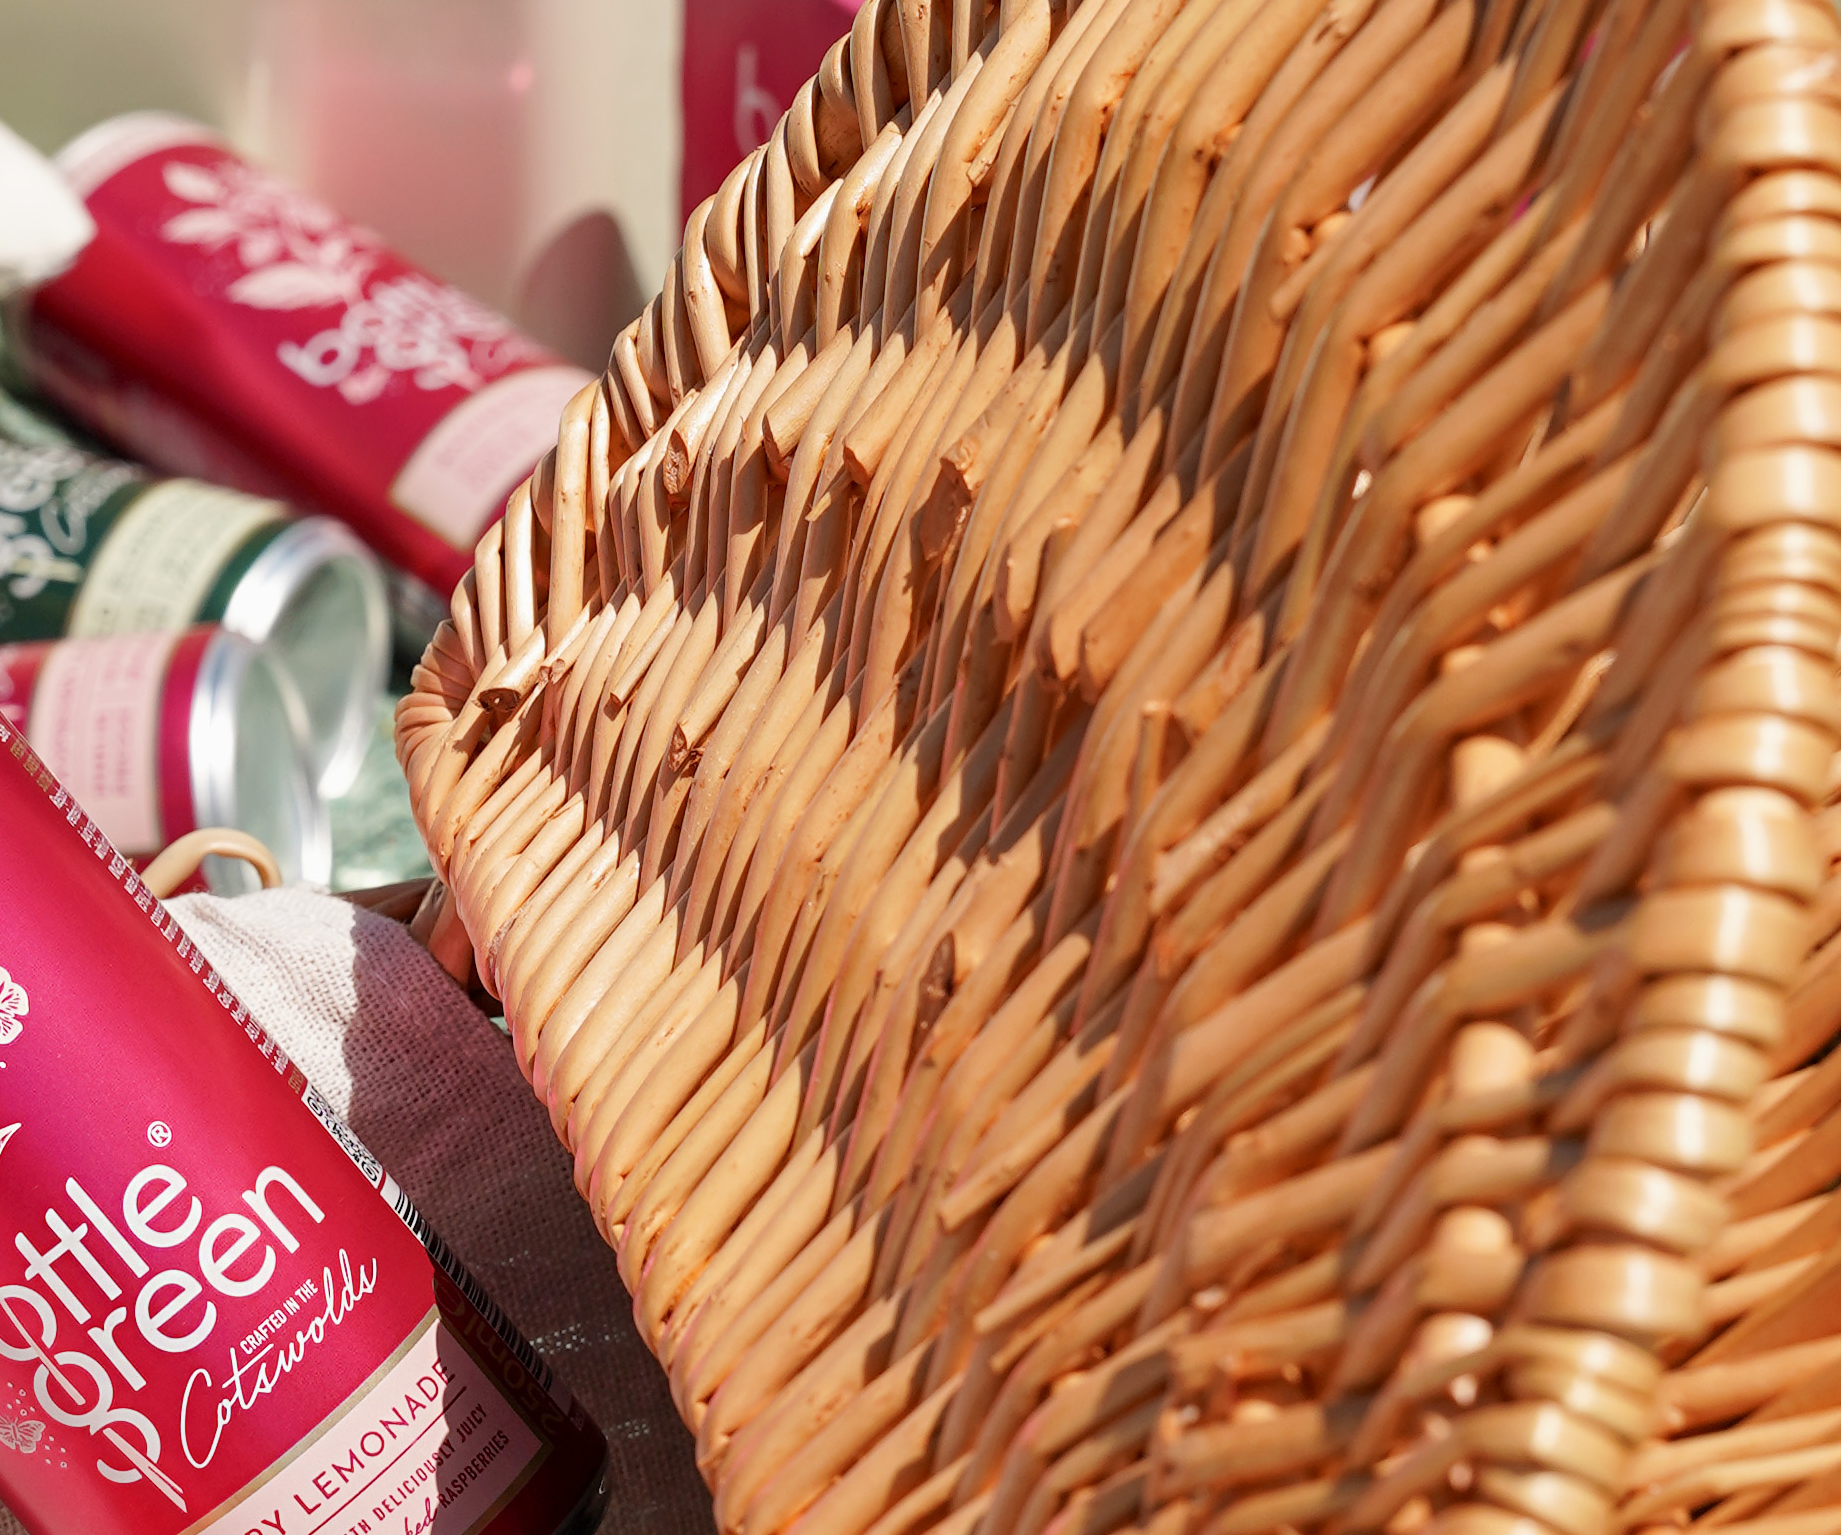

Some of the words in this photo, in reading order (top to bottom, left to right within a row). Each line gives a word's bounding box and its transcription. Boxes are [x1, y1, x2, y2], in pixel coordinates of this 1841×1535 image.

[34, 1166, 325, 1484] green
[181, 1249, 377, 1469] Cotswolds
[239, 1309, 288, 1355] CRAFTED
[283, 1297, 301, 1316] IN
[294, 1278, 319, 1303] THE
[293, 1359, 456, 1515] LEMONADE
[372, 1438, 457, 1523] DELICIOUSLY
[456, 1402, 488, 1444] JUICY
[437, 1429, 510, 1509] RASPBERRIES
